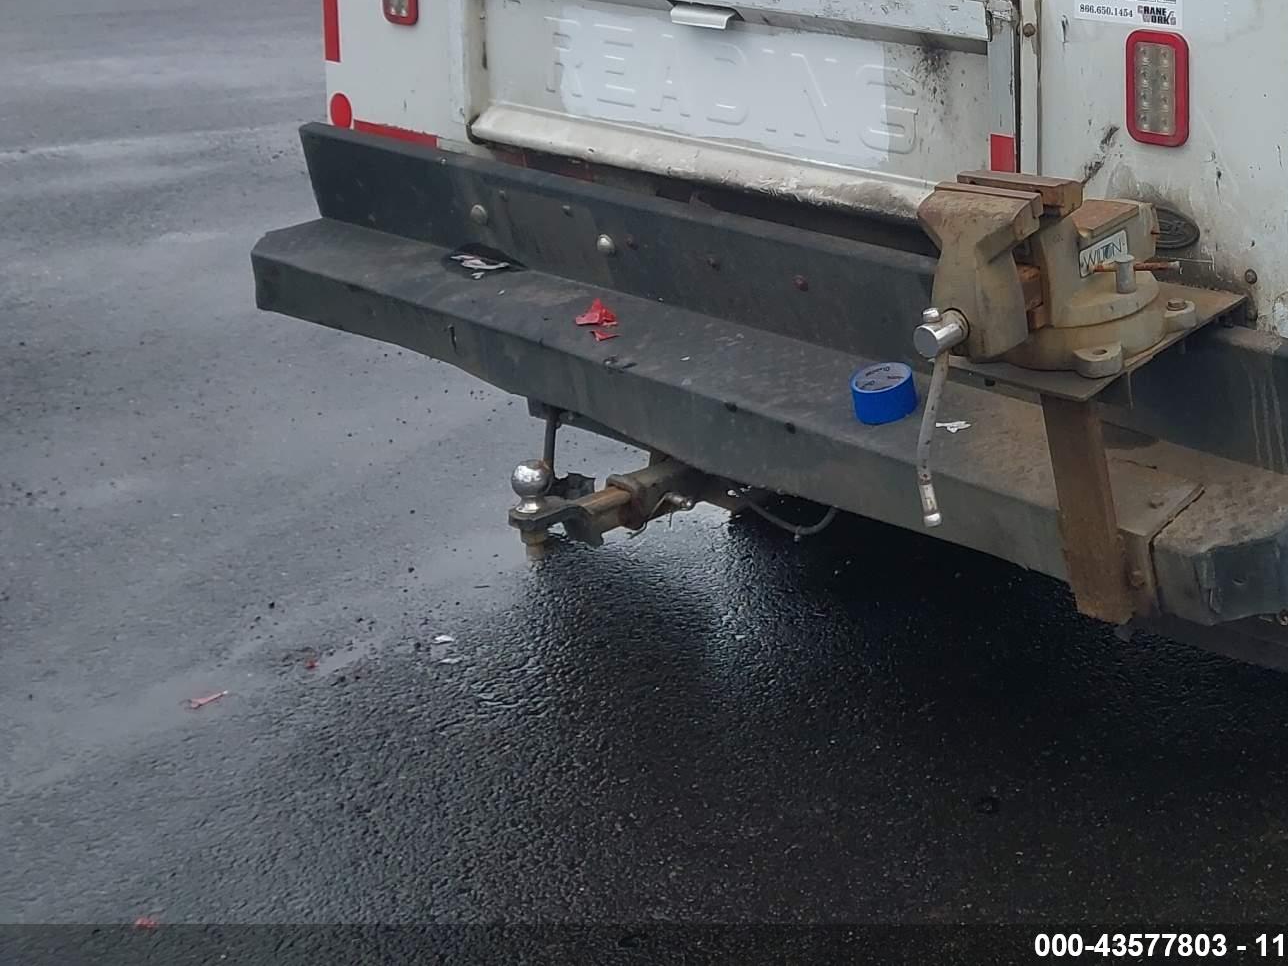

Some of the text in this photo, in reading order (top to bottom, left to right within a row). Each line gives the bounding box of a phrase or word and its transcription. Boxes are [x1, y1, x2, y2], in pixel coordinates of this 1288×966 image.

[1080, 3, 1133, 18] 866.650.1454
[1137, 5, 1167, 16] CRANE
[544, 15, 920, 155] READING
